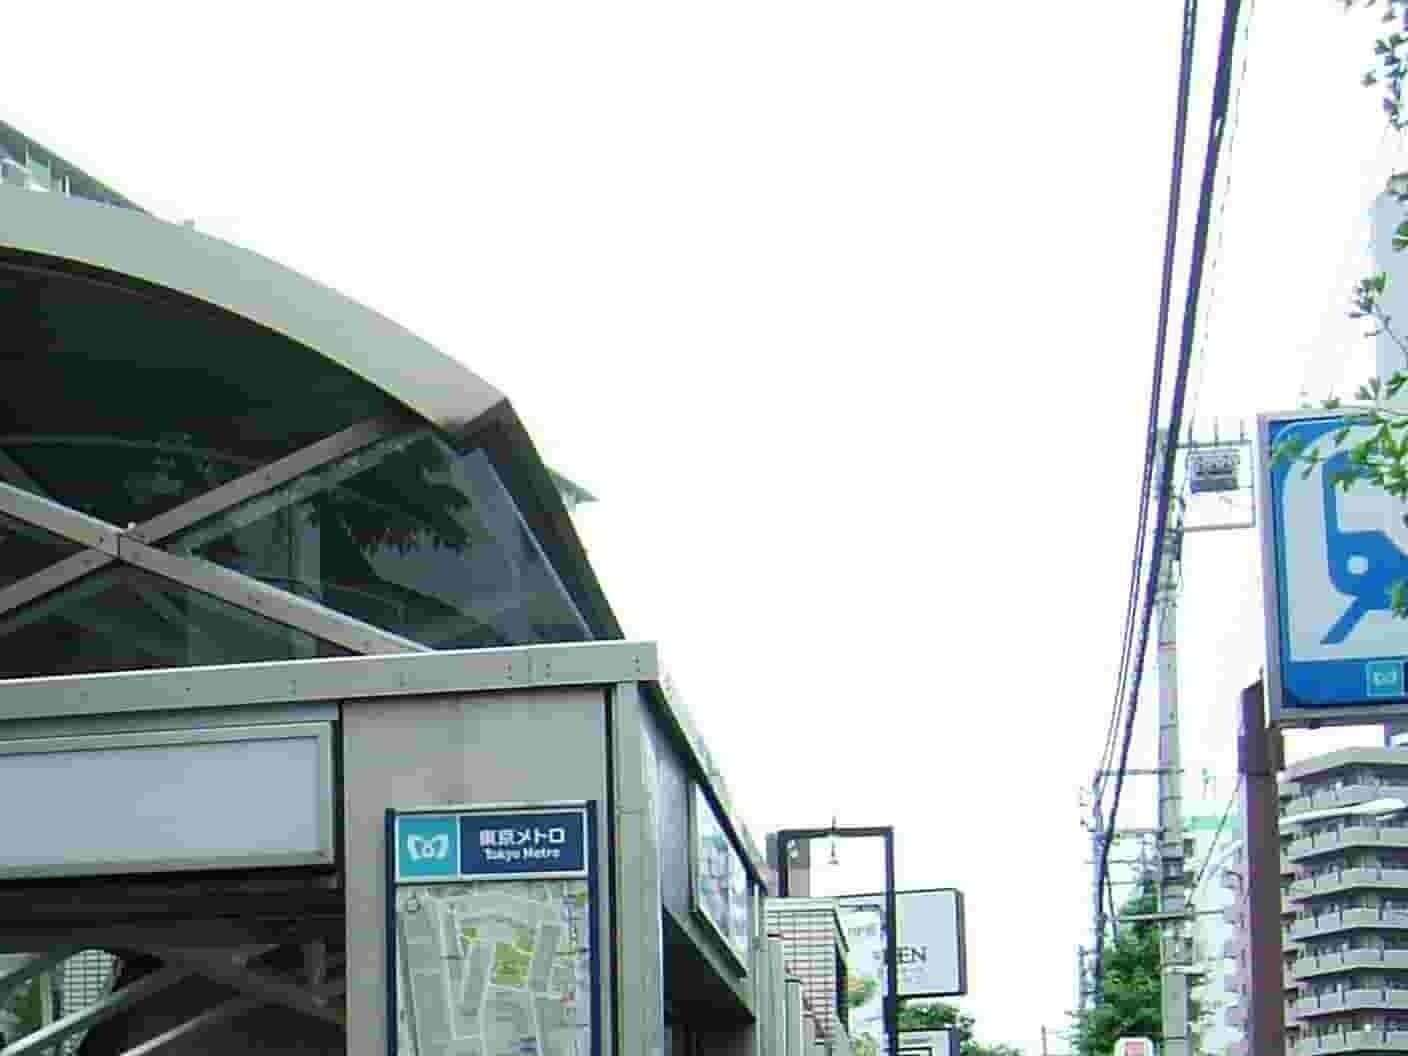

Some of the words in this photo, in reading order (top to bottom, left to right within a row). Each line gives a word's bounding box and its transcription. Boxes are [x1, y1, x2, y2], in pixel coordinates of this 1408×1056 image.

[480, 828, 565, 847] 東京メトロ
